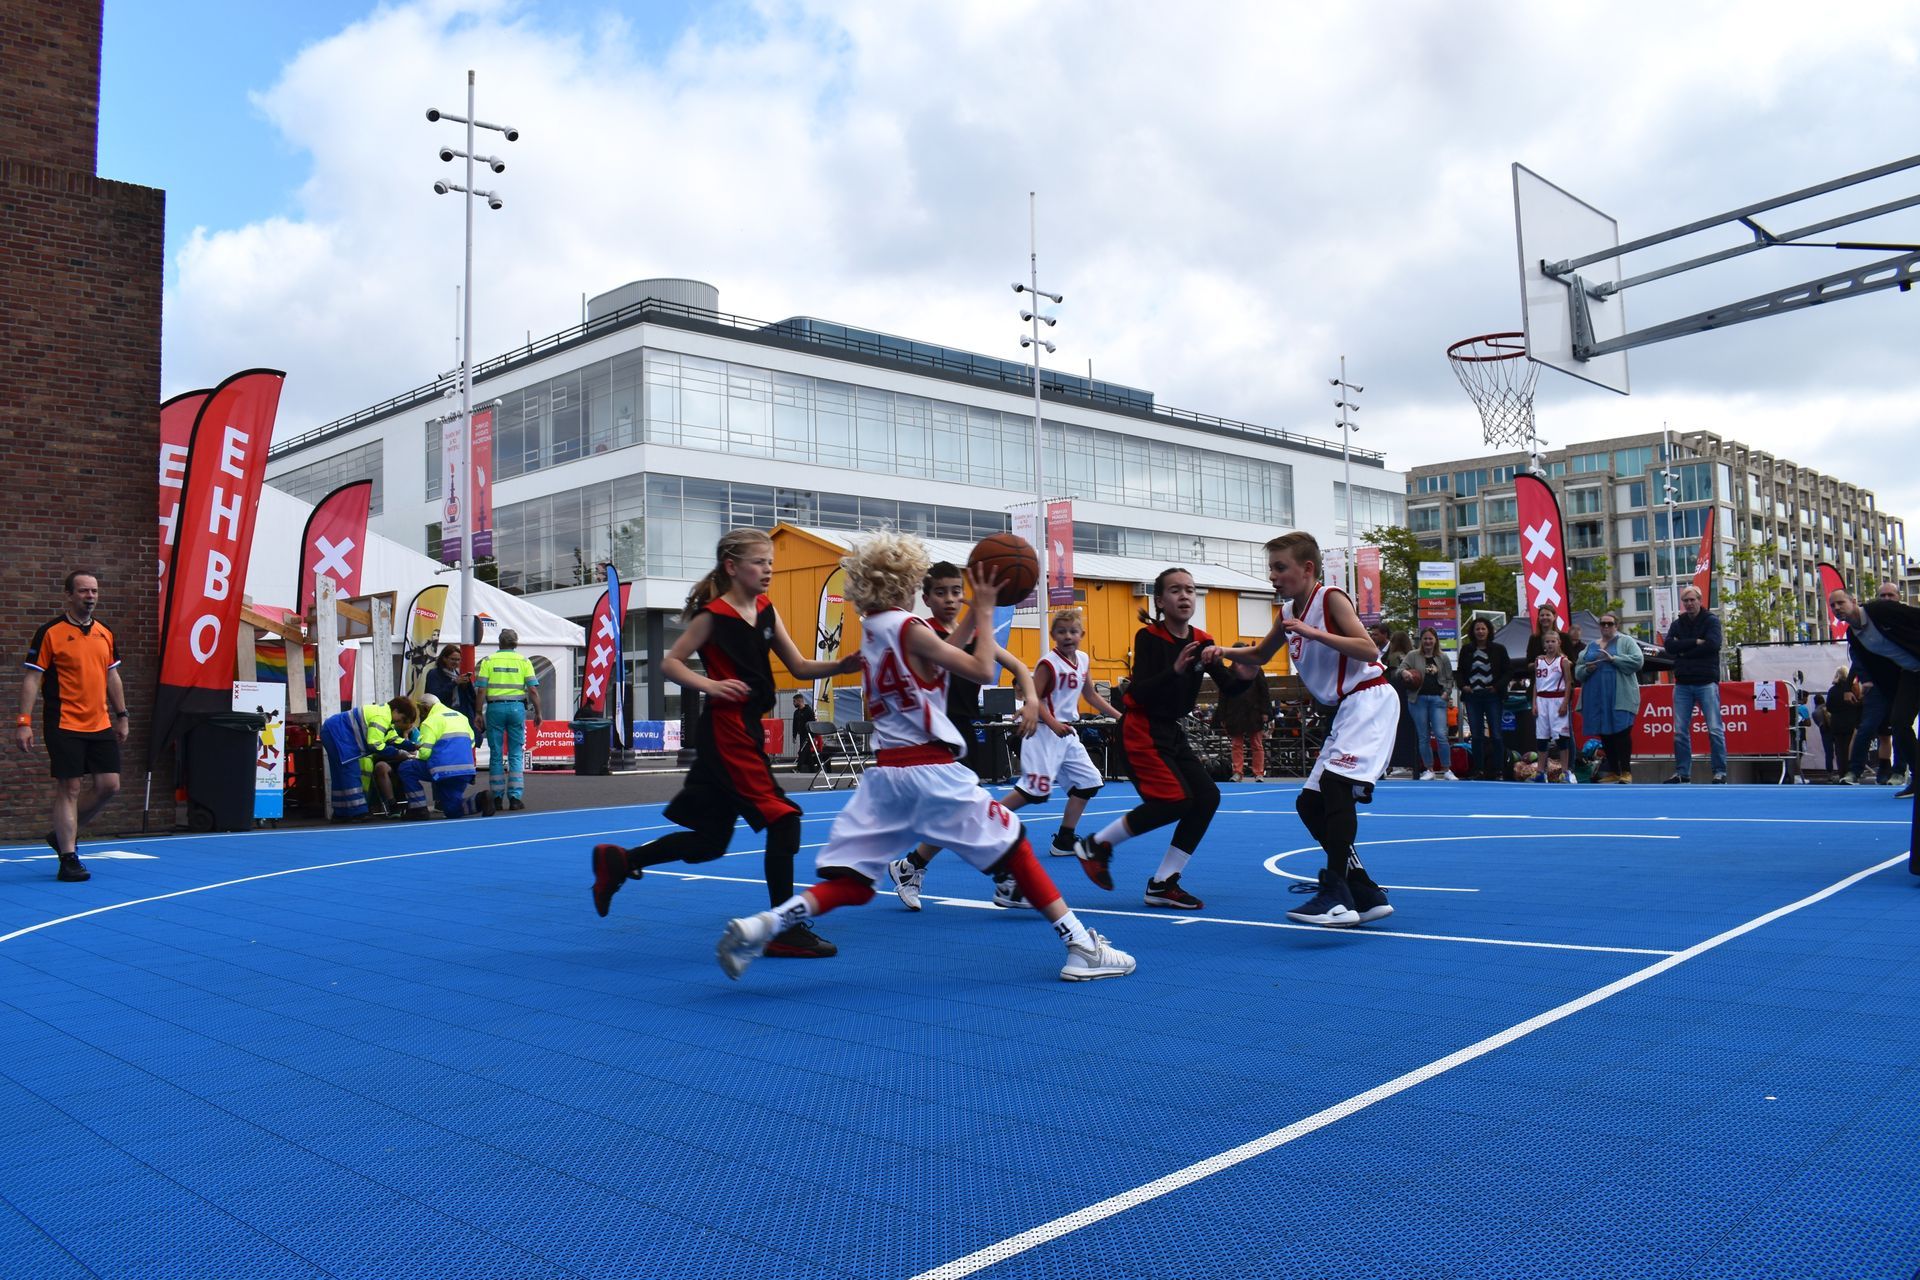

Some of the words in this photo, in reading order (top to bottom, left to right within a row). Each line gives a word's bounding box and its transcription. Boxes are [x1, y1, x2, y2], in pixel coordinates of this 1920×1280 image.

[190, 425, 250, 665] EHBO
[1536, 668, 1549, 678] 83
[1057, 672, 1079, 690] 76
[536, 730, 575, 739] Amsterda
[536, 739, 555, 748] sport
[1026, 773, 1050, 794] 76
